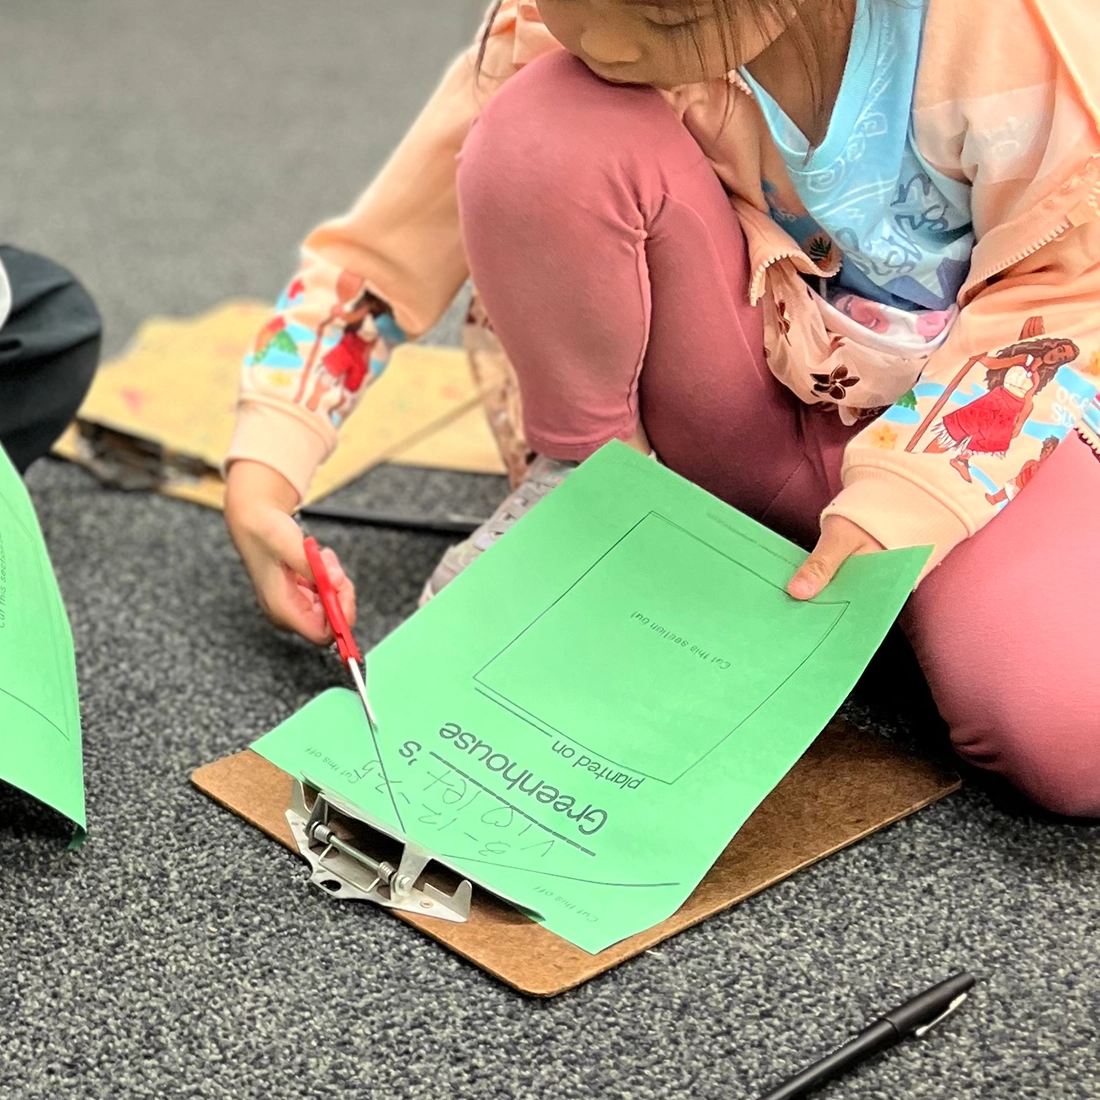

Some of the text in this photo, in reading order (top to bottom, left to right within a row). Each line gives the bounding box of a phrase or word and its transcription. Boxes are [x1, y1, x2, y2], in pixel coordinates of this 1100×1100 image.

[630, 611, 731, 670] Cut this section out
[304, 746, 359, 784] Cut this off
[438, 722, 608, 836] Greenhouse
[551, 740, 646, 790] planted on
[532, 886, 599, 923] Cut this off
